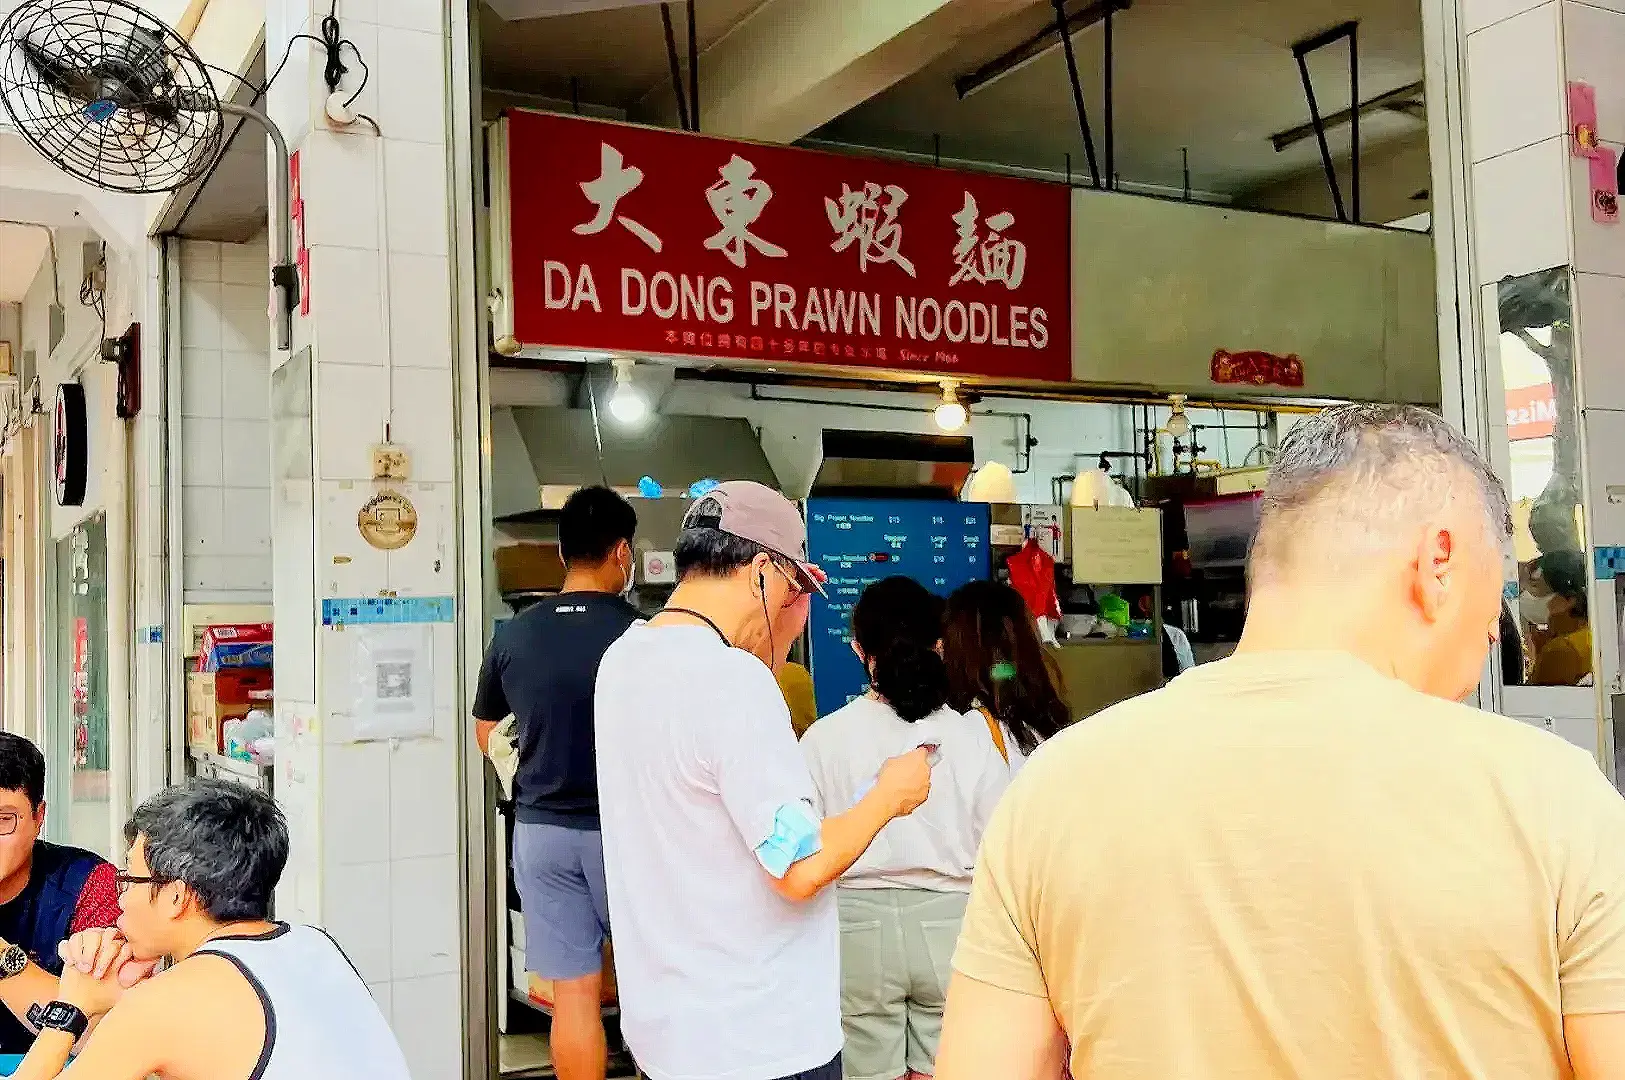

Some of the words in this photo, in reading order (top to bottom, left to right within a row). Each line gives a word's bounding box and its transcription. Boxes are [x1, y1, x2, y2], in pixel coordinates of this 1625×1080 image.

[571, 140, 1028, 290] 大東蝦麵
[543, 260, 602, 314] DA
[621, 268, 735, 325] DONG
[750, 281, 882, 337] PRAWN
[895, 296, 1049, 349] NOODLES
